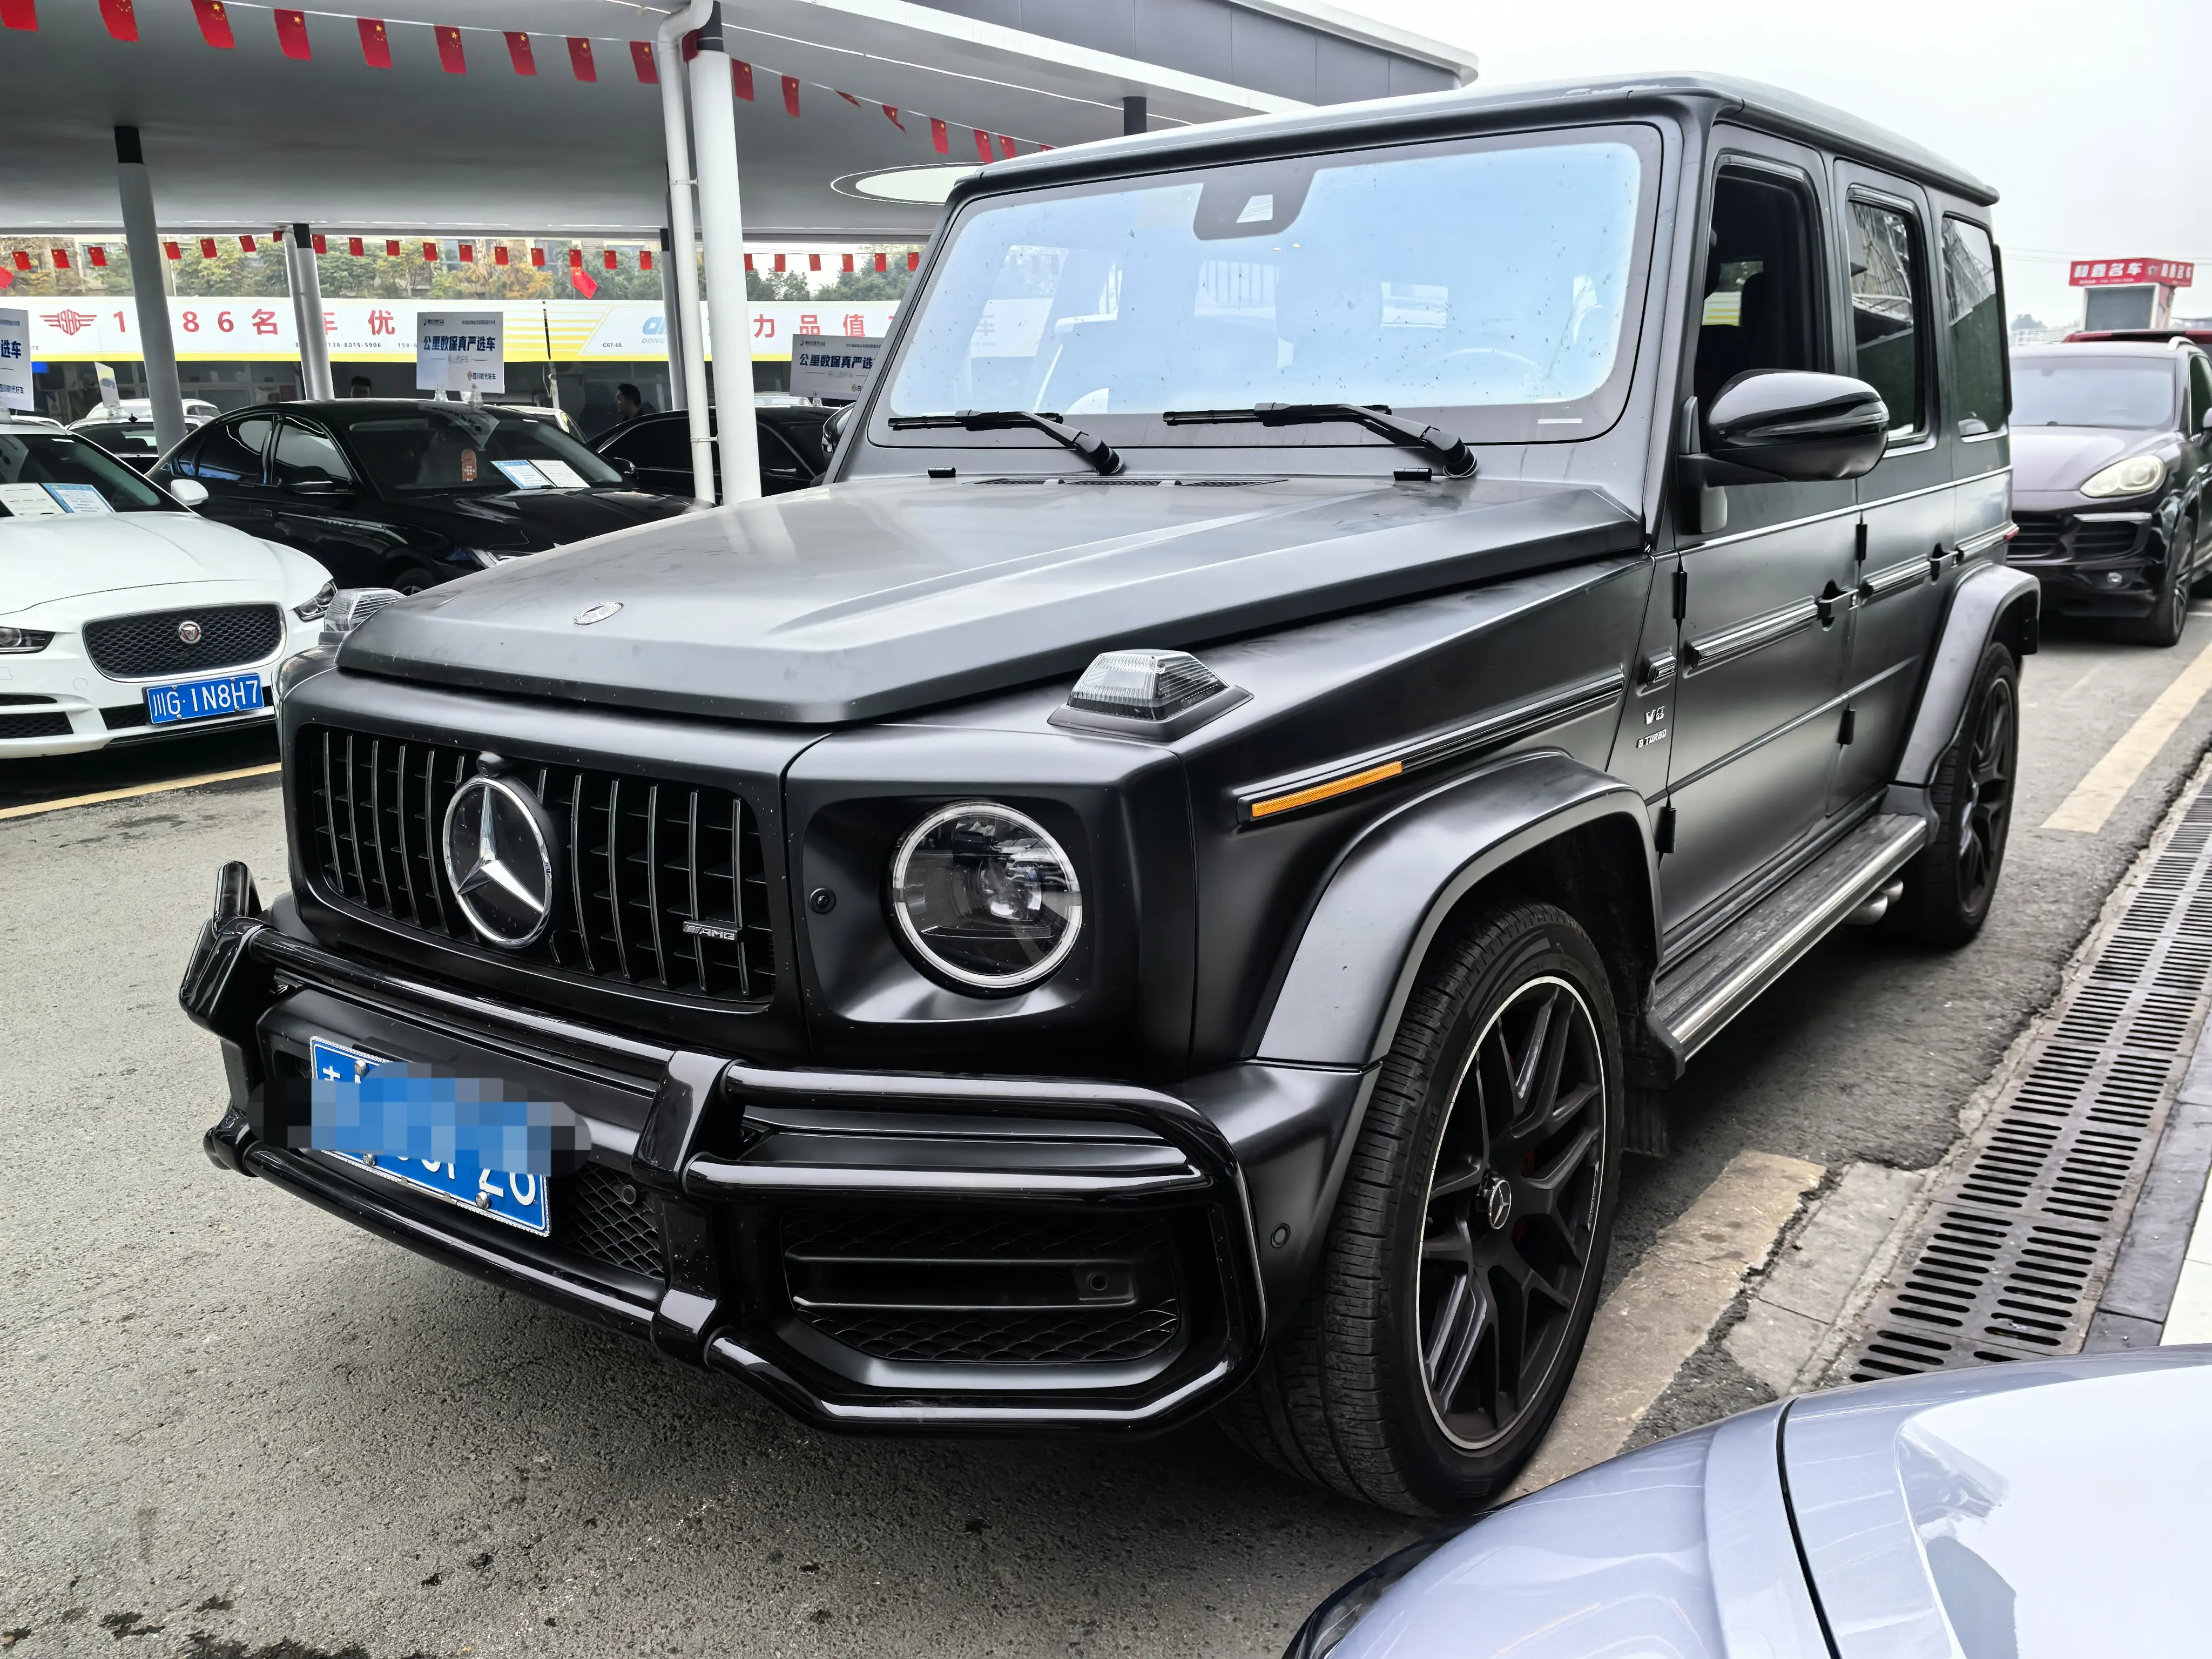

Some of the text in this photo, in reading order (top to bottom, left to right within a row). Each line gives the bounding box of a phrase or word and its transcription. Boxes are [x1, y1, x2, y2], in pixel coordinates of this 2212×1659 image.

[0, 339, 22, 359] 选车
[423, 335, 496, 352] 公里数保真严选车
[799, 354, 874, 369] 公里数保真严选
[1645, 706, 1665, 725] V8
[699, 929, 736, 941] AMG
